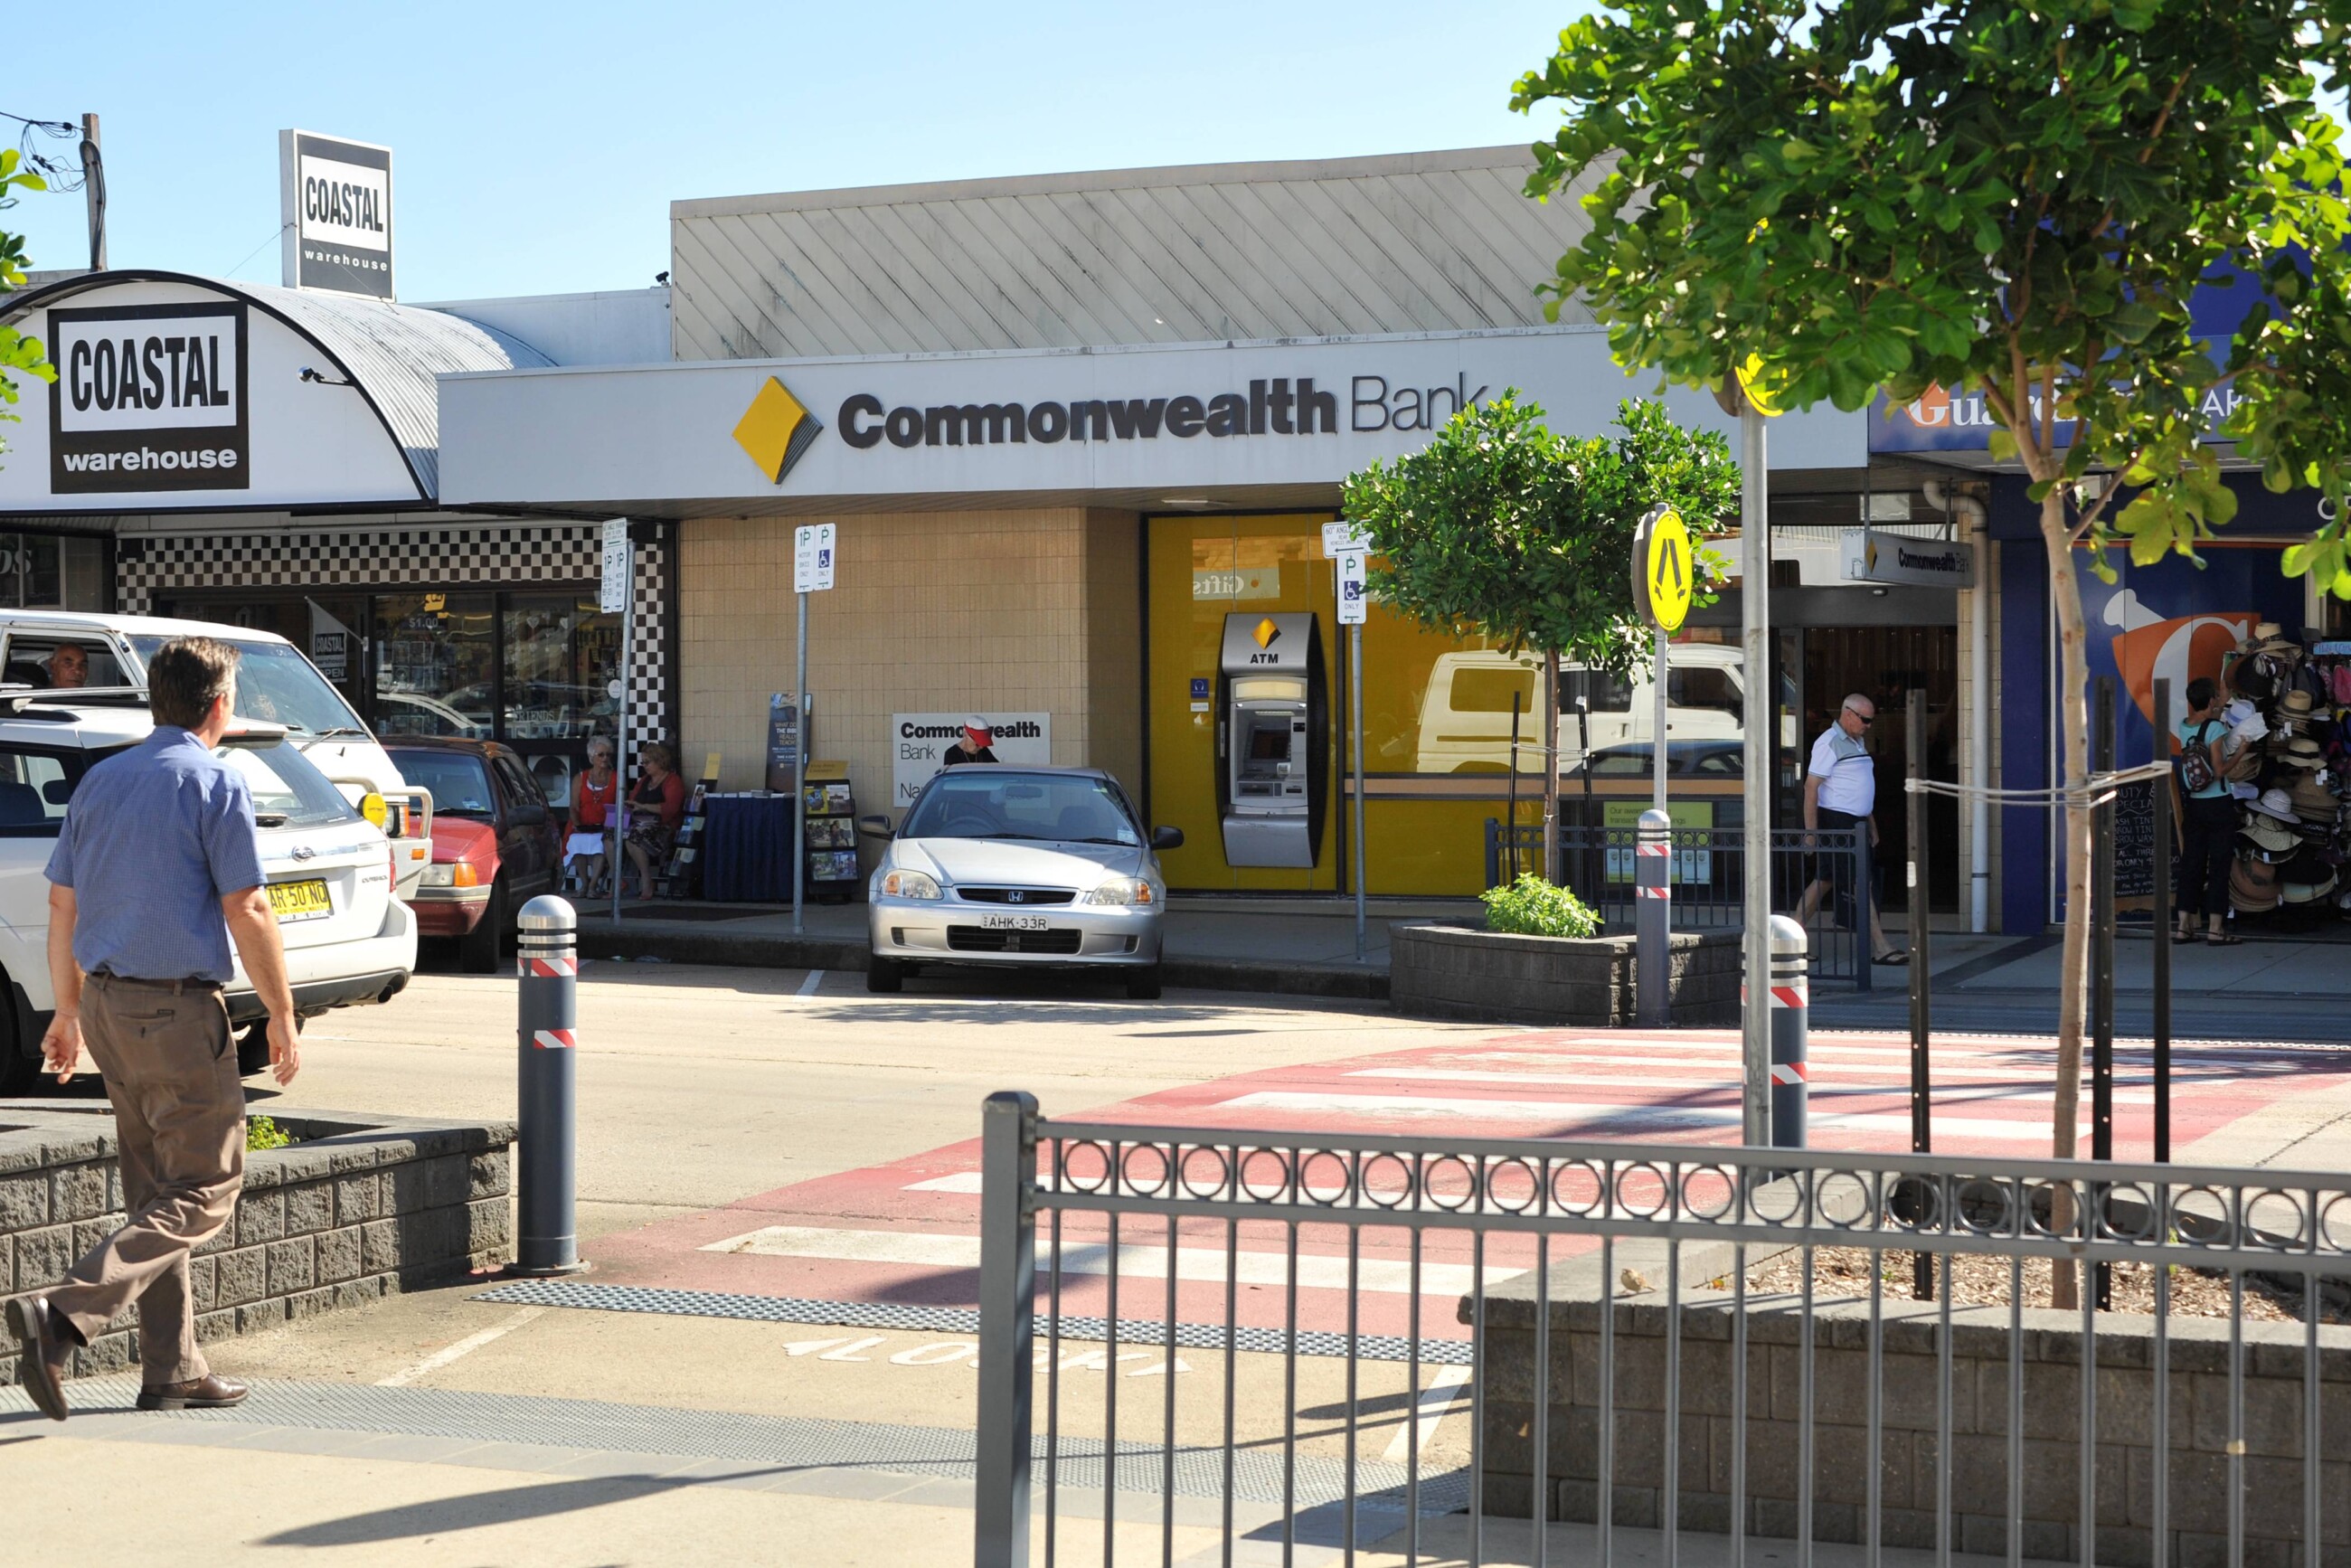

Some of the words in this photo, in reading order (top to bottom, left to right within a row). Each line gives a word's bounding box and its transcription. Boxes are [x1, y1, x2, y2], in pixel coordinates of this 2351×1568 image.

[306, 176, 384, 232] COASTAL
[304, 250, 388, 272] warehouse
[71, 335, 230, 412] COASTAL
[1352, 371, 1489, 432] Bank
[837, 378, 1337, 449] Commonwealth
[62, 447, 238, 473] warehouse
[799, 531, 811, 547] 1P
[821, 528, 829, 544] P
[1345, 558, 1356, 575] P
[1898, 546, 1956, 572] Commonwealth
[1250, 653, 1279, 665] ATM
[901, 721, 1041, 739] Commoealth
[901, 743, 937, 760] Bank
